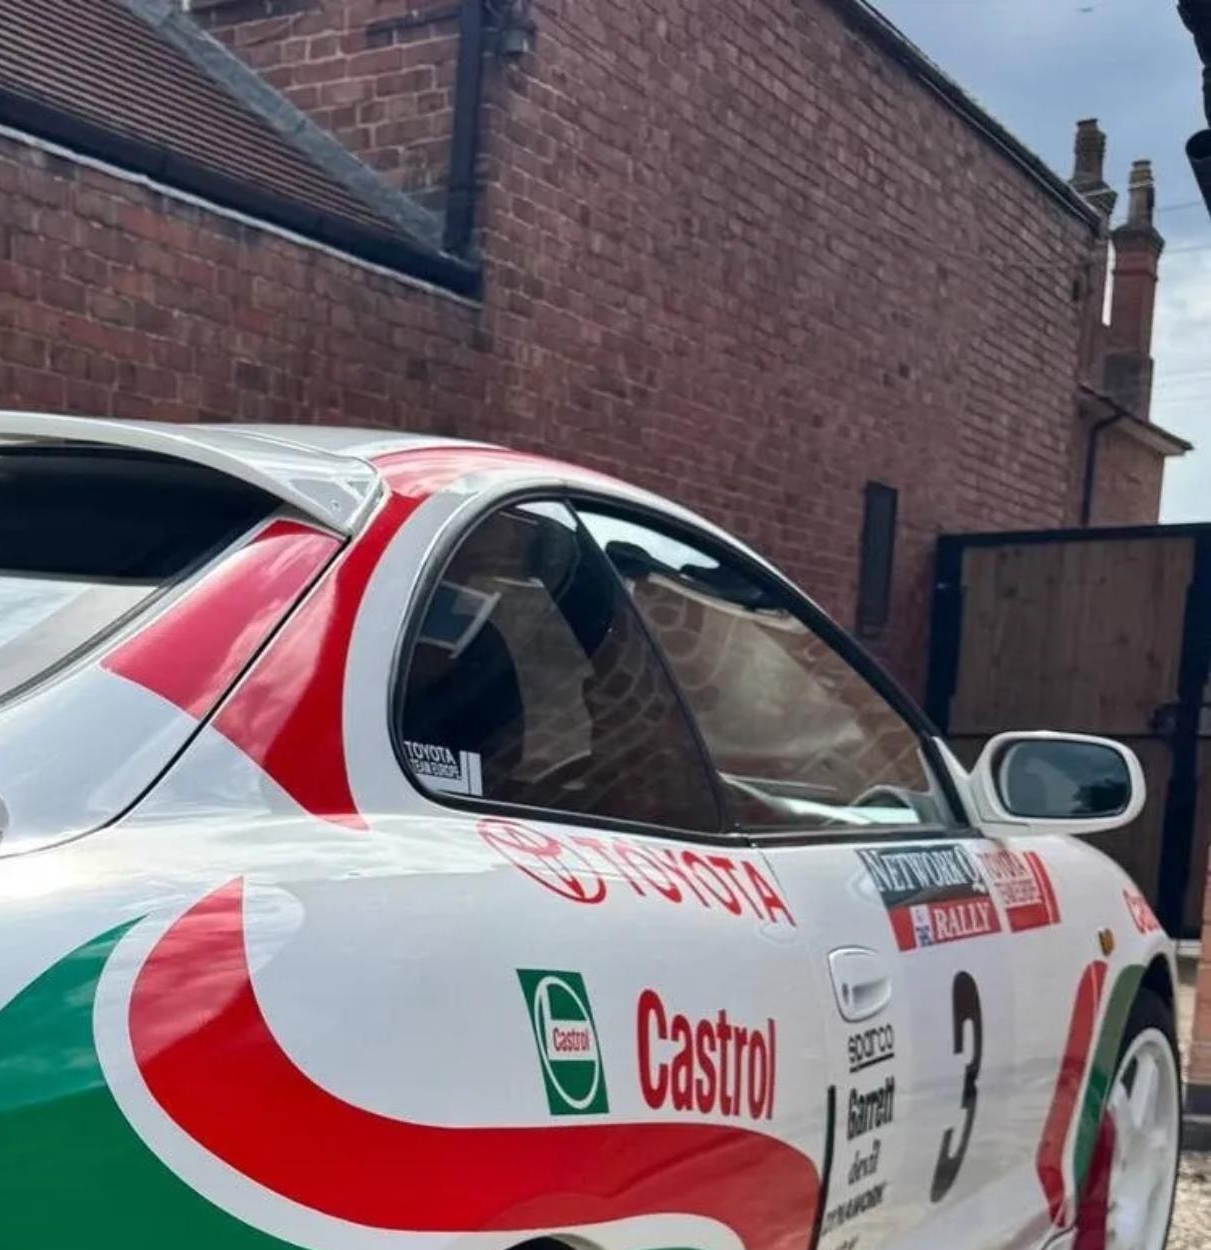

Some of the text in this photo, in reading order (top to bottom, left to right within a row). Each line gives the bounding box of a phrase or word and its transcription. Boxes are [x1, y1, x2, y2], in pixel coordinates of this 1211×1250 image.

[403, 740, 457, 765] TOYOTA
[565, 834, 797, 928] TOYOTA
[932, 901, 993, 940] RALLY
[553, 1027, 590, 1052] Castrol
[637, 988, 776, 1121] Castrol
[848, 1023, 895, 1064] sparco
[847, 1075, 895, 1141] Garrett
[930, 971, 983, 1203] 3
